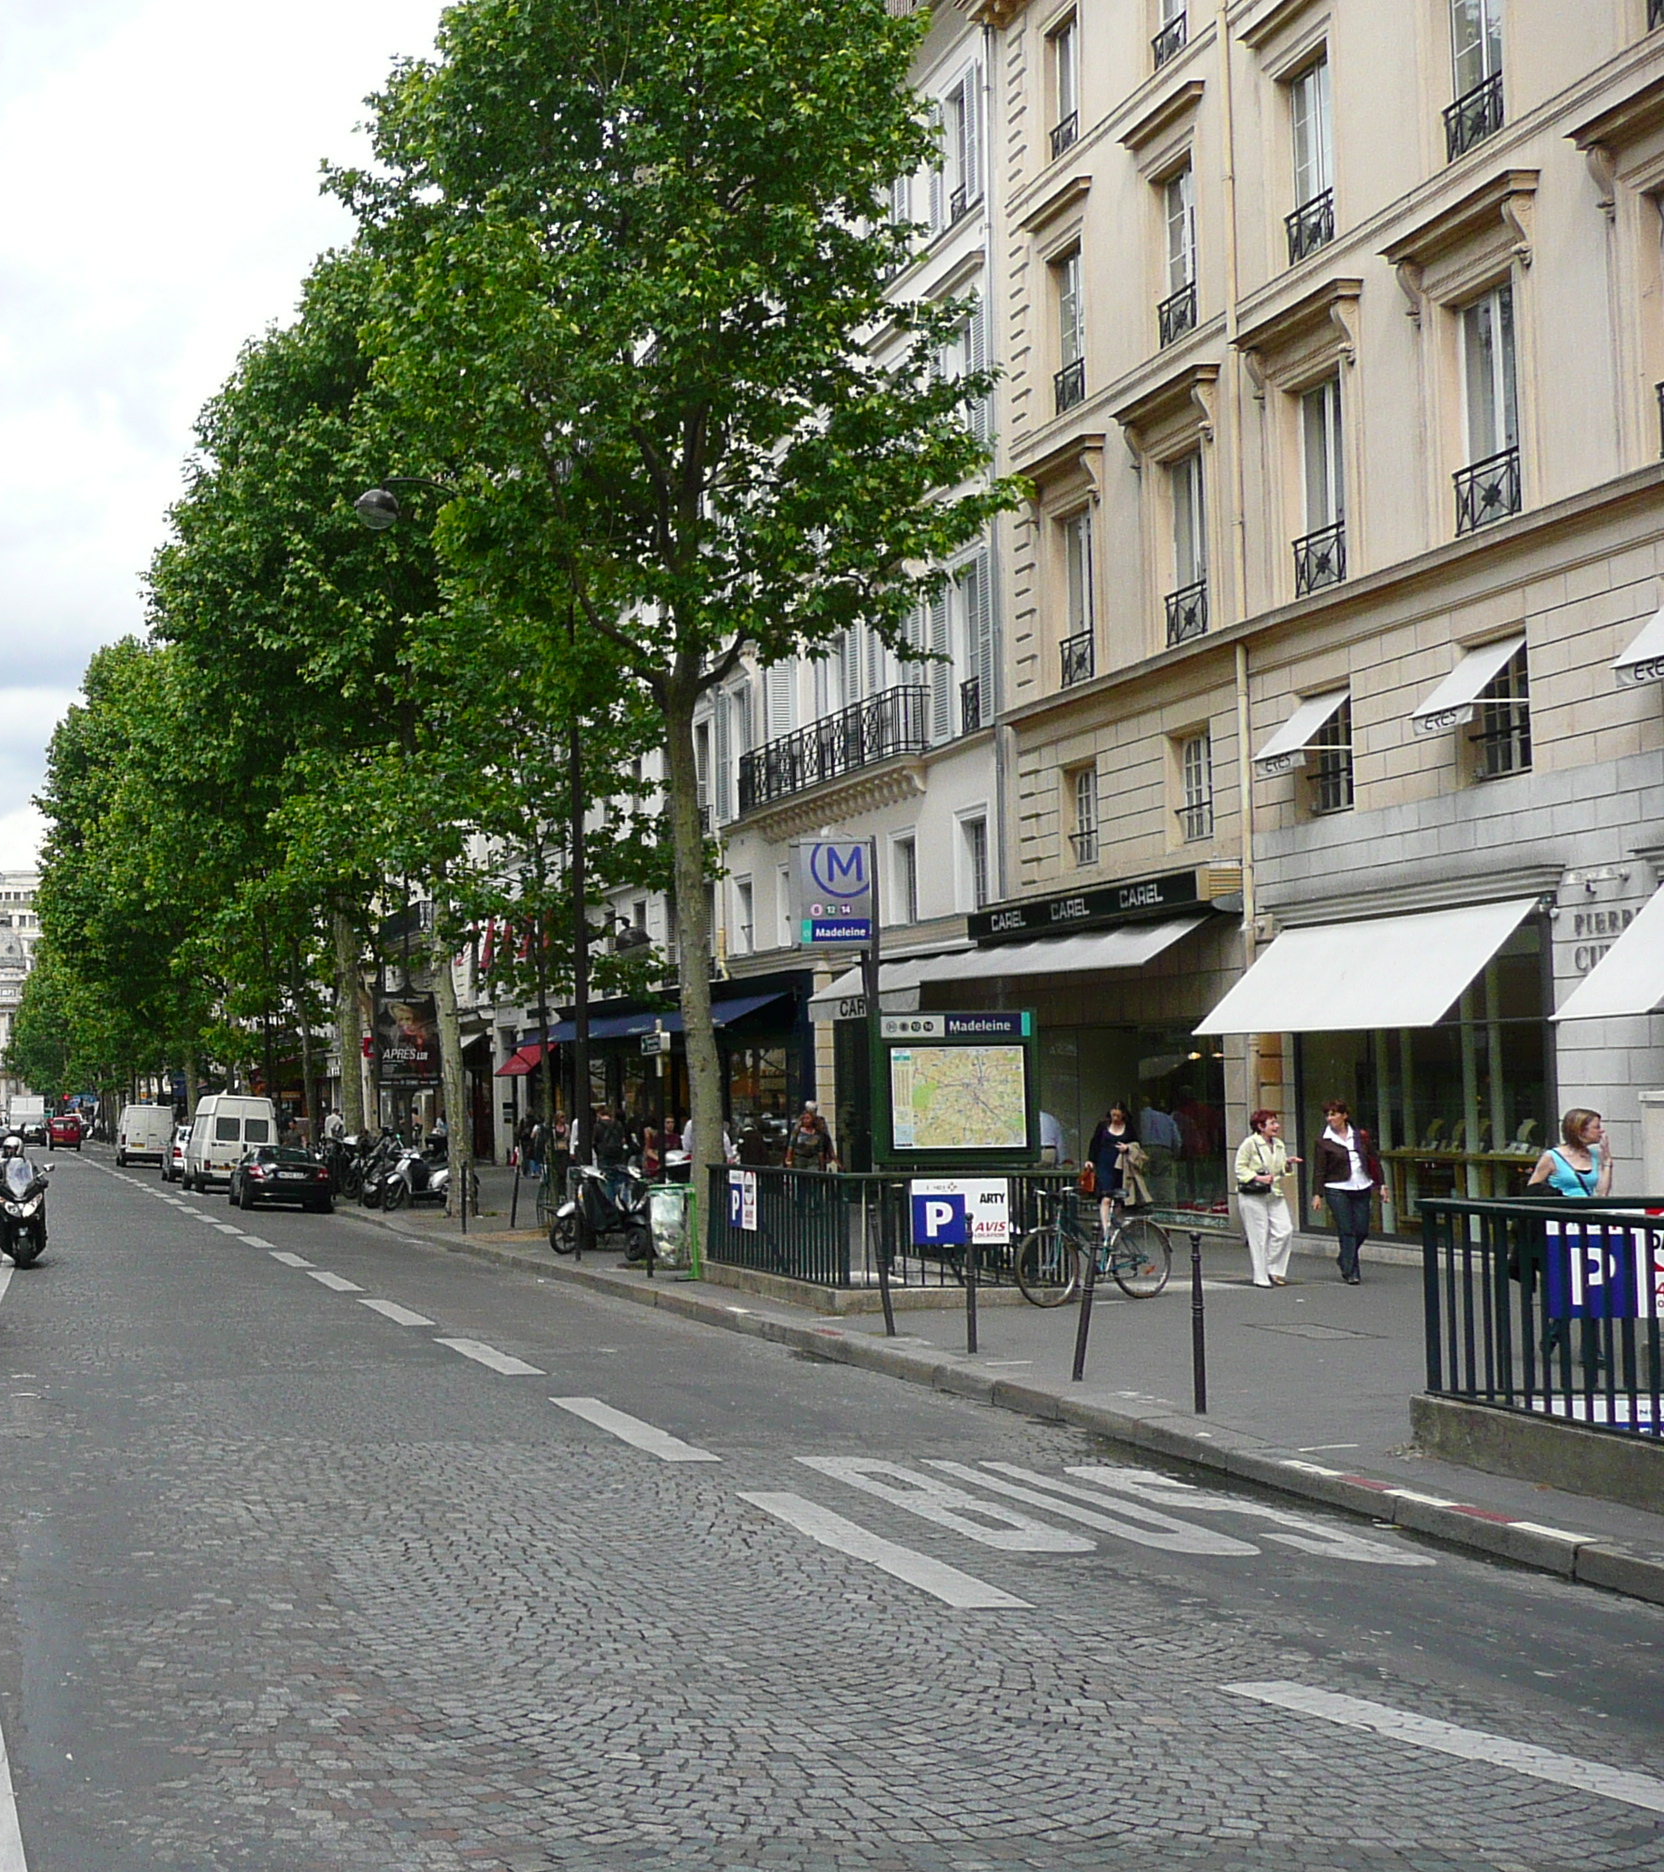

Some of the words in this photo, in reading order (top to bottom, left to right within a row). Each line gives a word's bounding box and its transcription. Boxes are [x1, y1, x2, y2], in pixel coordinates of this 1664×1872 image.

[1634, 657, 1664, 680] ERE
[827, 846, 863, 882] M
[1119, 884, 1164, 908] CAREL
[1051, 898, 1091, 921] CAREL
[815, 927, 866, 937] Madeleine
[991, 911, 1026, 932] CAREL
[1574, 906, 1643, 937] PIERR
[949, 1020, 1011, 1032] Madeleine
[732, 1190, 740, 1220] P
[926, 1202, 953, 1237] P
[975, 1222, 1006, 1232] AVIS
[793, 1455, 1437, 1567] BUS
